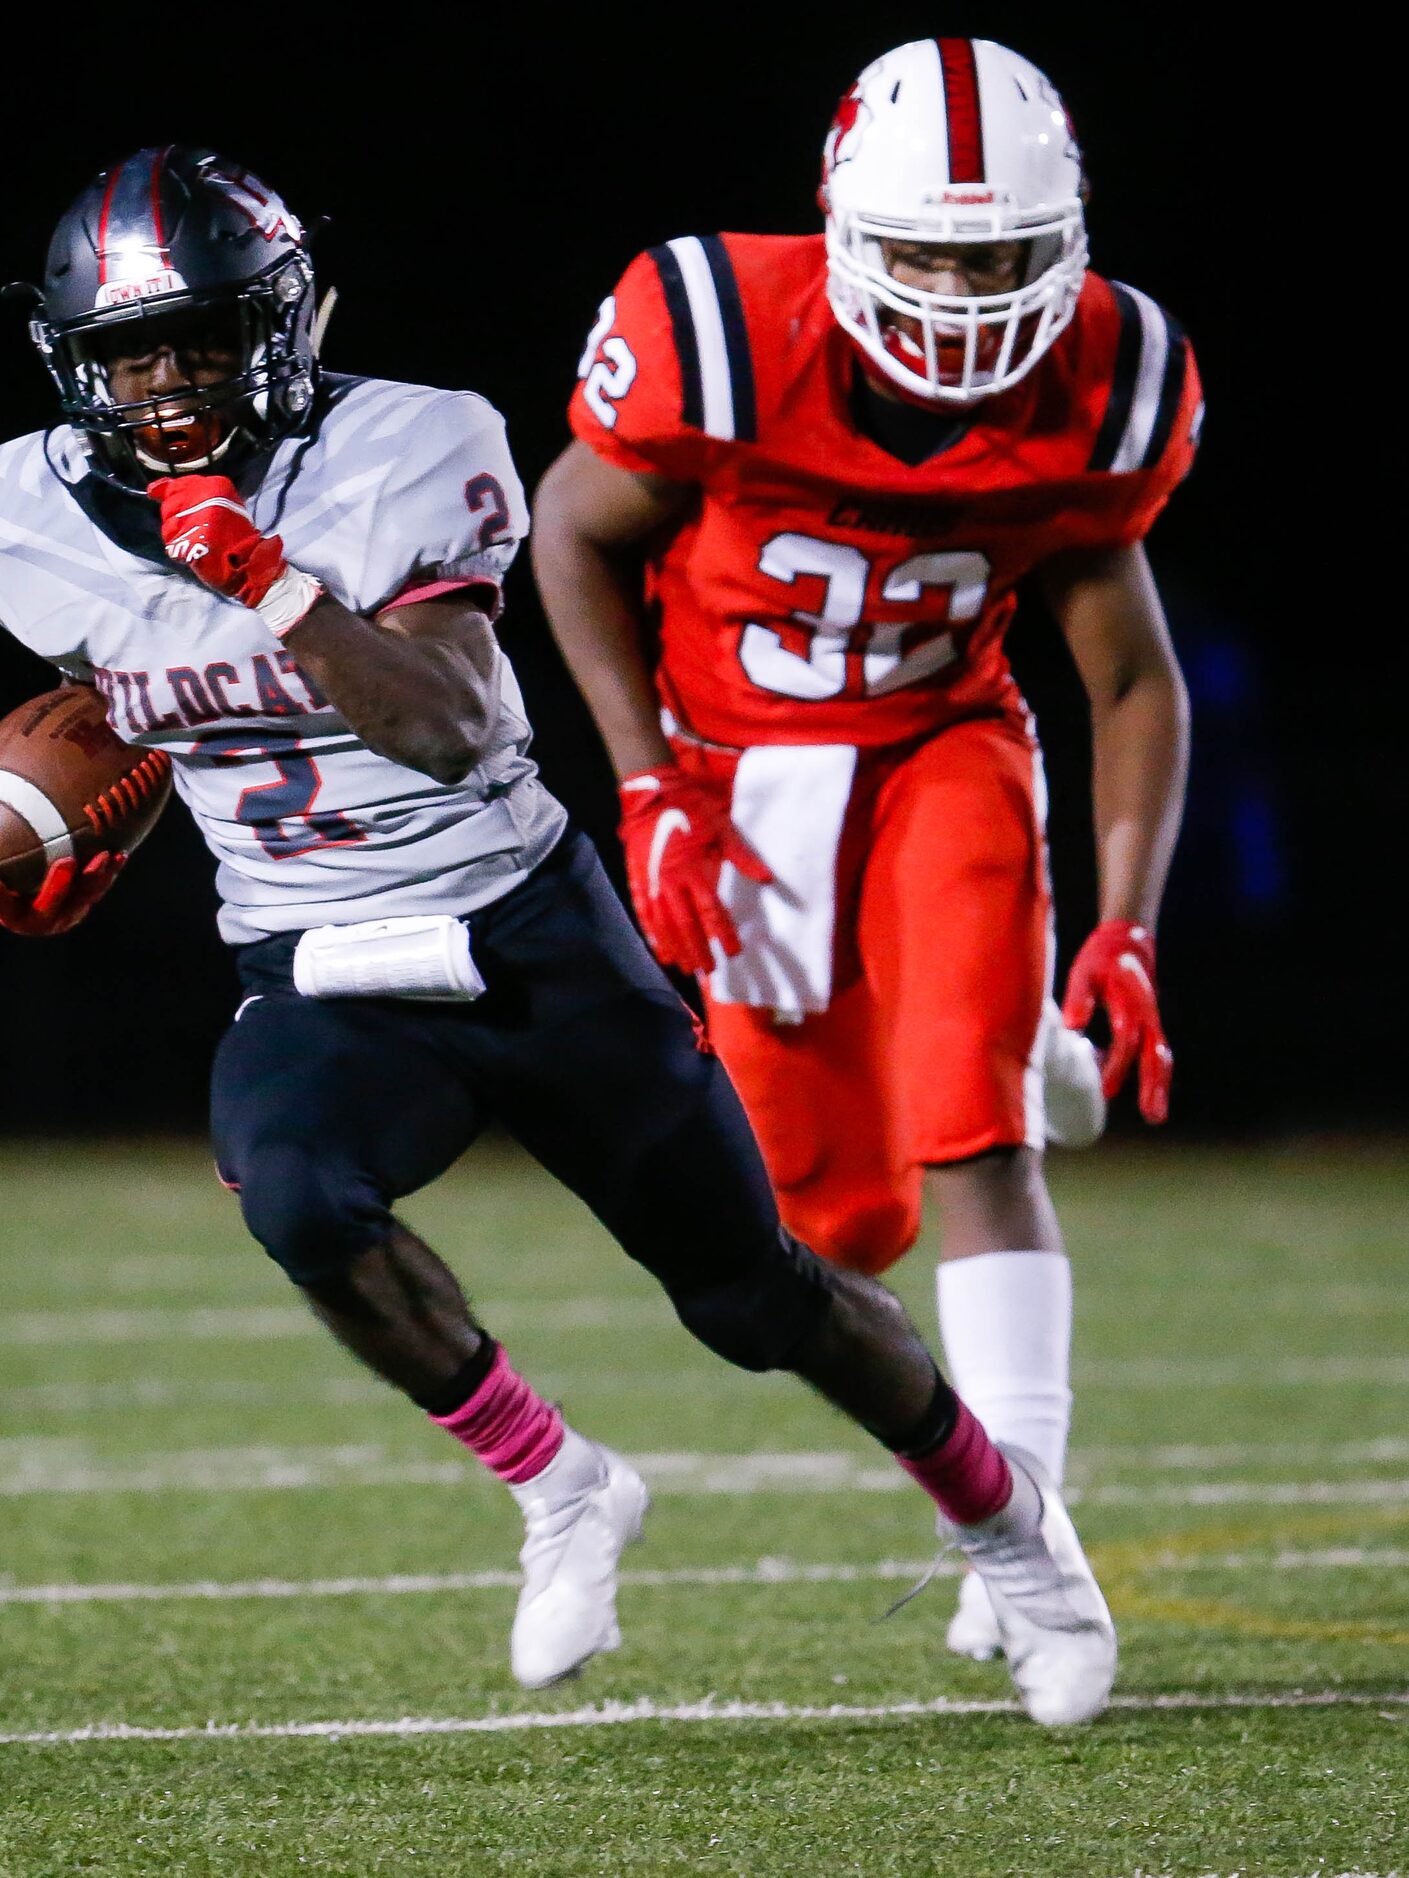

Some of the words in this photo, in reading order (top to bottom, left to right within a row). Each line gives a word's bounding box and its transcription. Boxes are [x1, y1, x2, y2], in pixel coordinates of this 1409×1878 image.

[463, 472, 514, 552] 2
[740, 532, 991, 700] 32
[191, 728, 367, 860] 2
